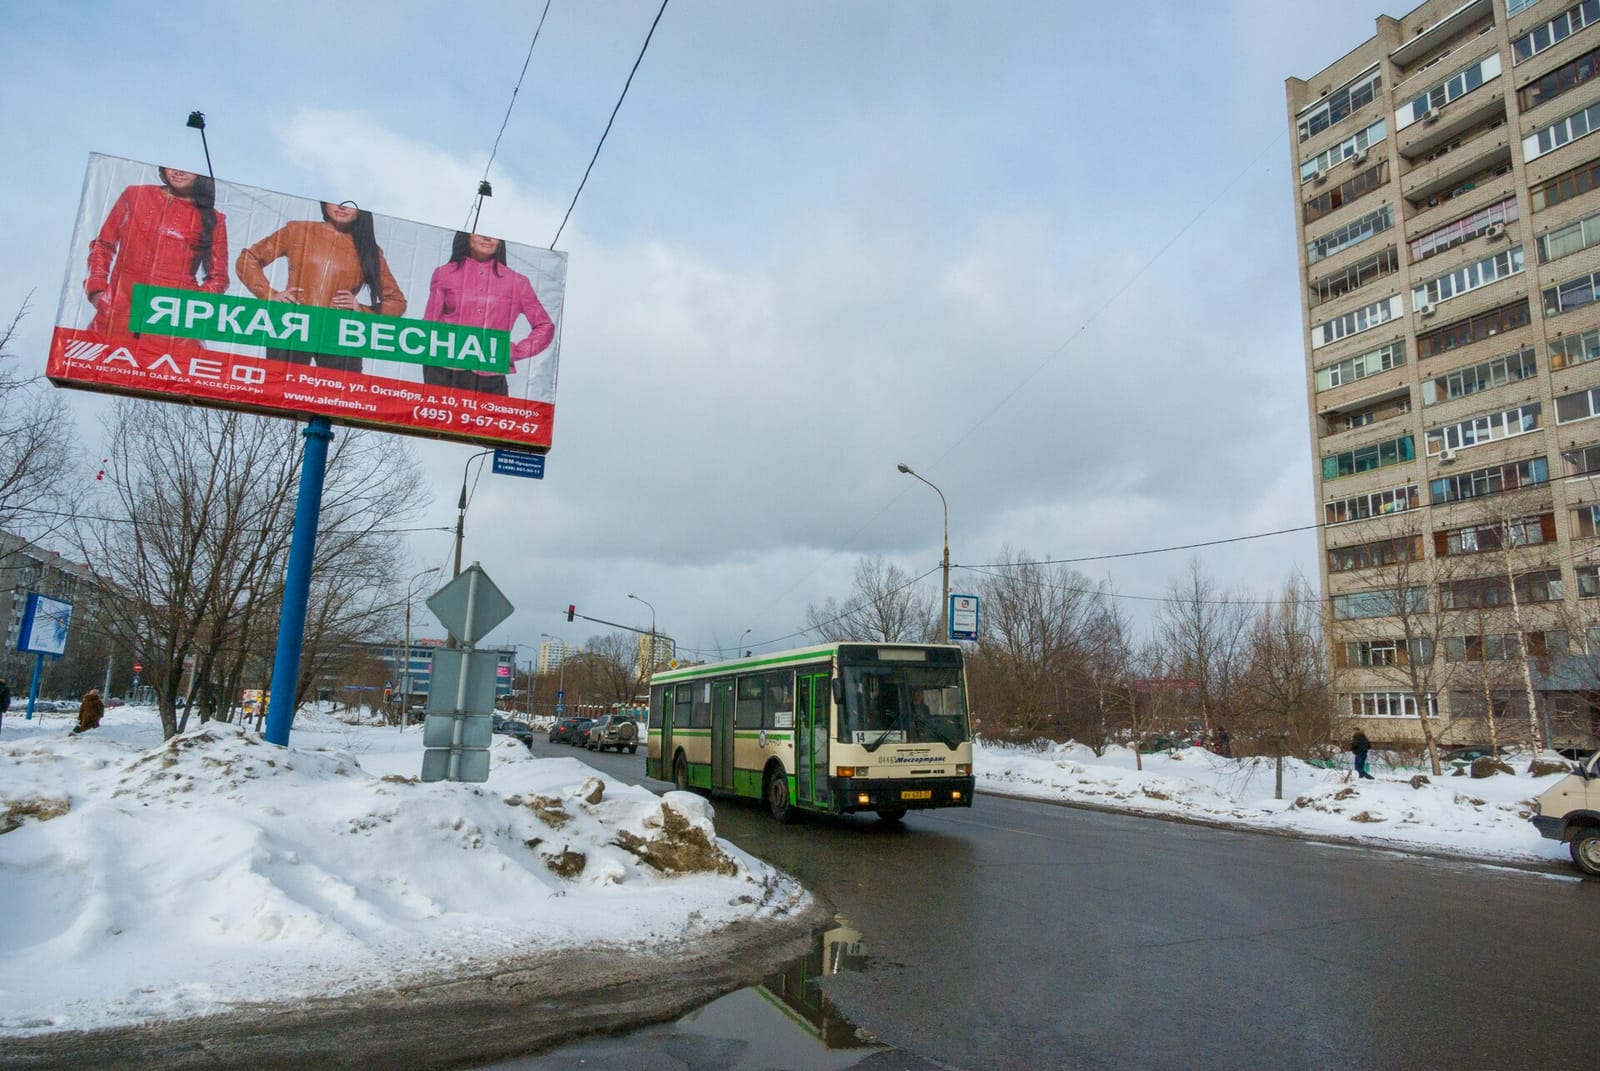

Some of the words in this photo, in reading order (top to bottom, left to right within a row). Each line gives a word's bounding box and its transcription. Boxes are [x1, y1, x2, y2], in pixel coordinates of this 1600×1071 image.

[146, 295, 310, 343] ЯРКАЯ
[338, 317, 497, 364] ВЕСНА!
[62, 360, 92, 370] МЕХА
[96, 365, 146, 378] ВЕРХНЯЯ
[149, 373, 191, 384] ОДЕЖДА
[195, 379, 264, 394] АКСЕССУАРЫ
[103, 347, 266, 384] АЛЕФ
[283, 392, 377, 411] www.alefmeh.ru
[285, 373, 296, 382] г.
[299, 374, 345, 391] Реутов,
[349, 382, 367, 392] ул.
[371, 385, 424, 401] Октября,
[427, 395, 438, 404] д.
[441, 395, 458, 408] 10,
[461, 398, 477, 410] ТЦ
[480, 402, 539, 418] «Экватор»
[413, 406, 453, 424] (495)
[461, 413, 538, 434] 9-67-67-67
[856, 732, 865, 743] 14
